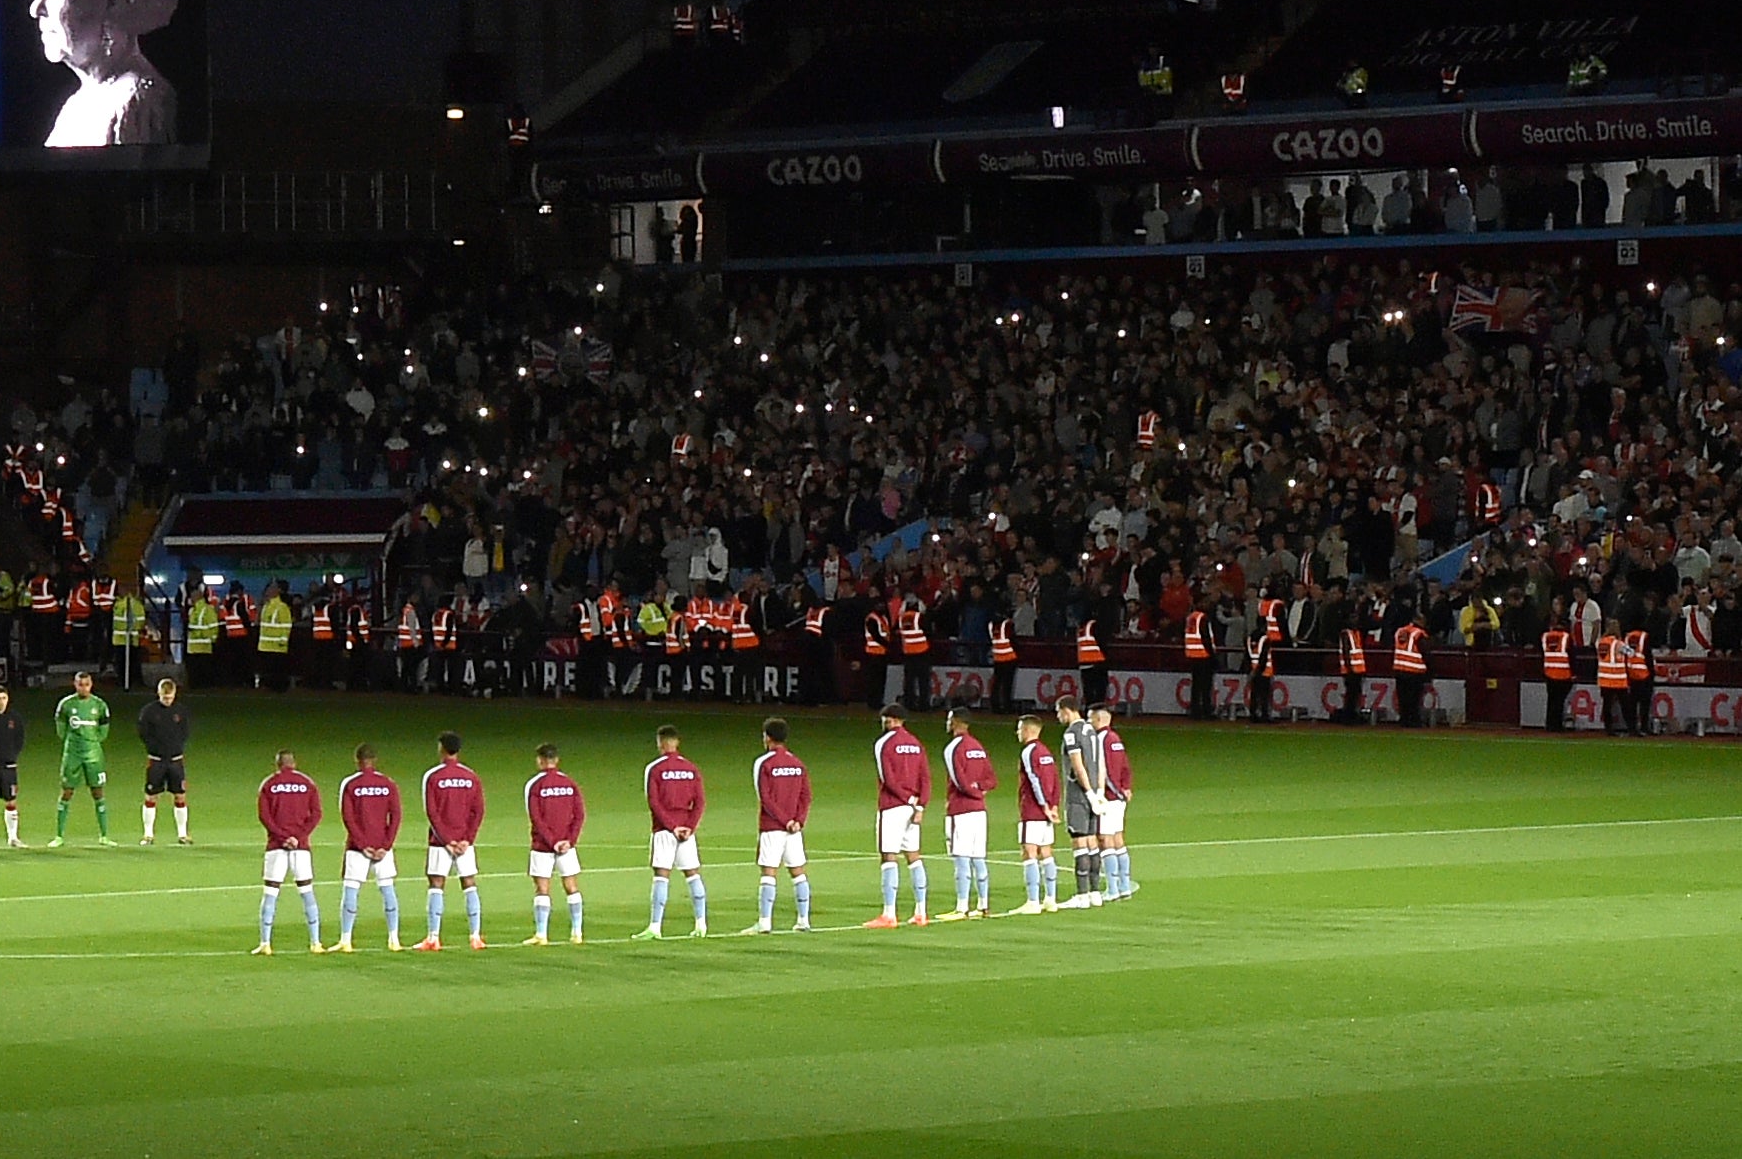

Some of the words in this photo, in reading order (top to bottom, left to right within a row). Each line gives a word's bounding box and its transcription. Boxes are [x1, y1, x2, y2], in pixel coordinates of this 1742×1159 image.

[1521, 123, 1593, 145] Search.
[1596, 119, 1652, 142] Drive.
[1657, 114, 1718, 140] Smile.
[1042, 148, 1090, 168] Drive.
[1093, 144, 1146, 166] Smile.
[1272, 127, 1385, 162] CAZOO
[768, 154, 862, 186] CAZOO
[1036, 673, 1146, 705] CAOO
[270, 783, 308, 794] CAZOO
[353, 786, 390, 797] CAZOO
[438, 778, 473, 789] CAZOO
[539, 786, 574, 797] CAZOO
